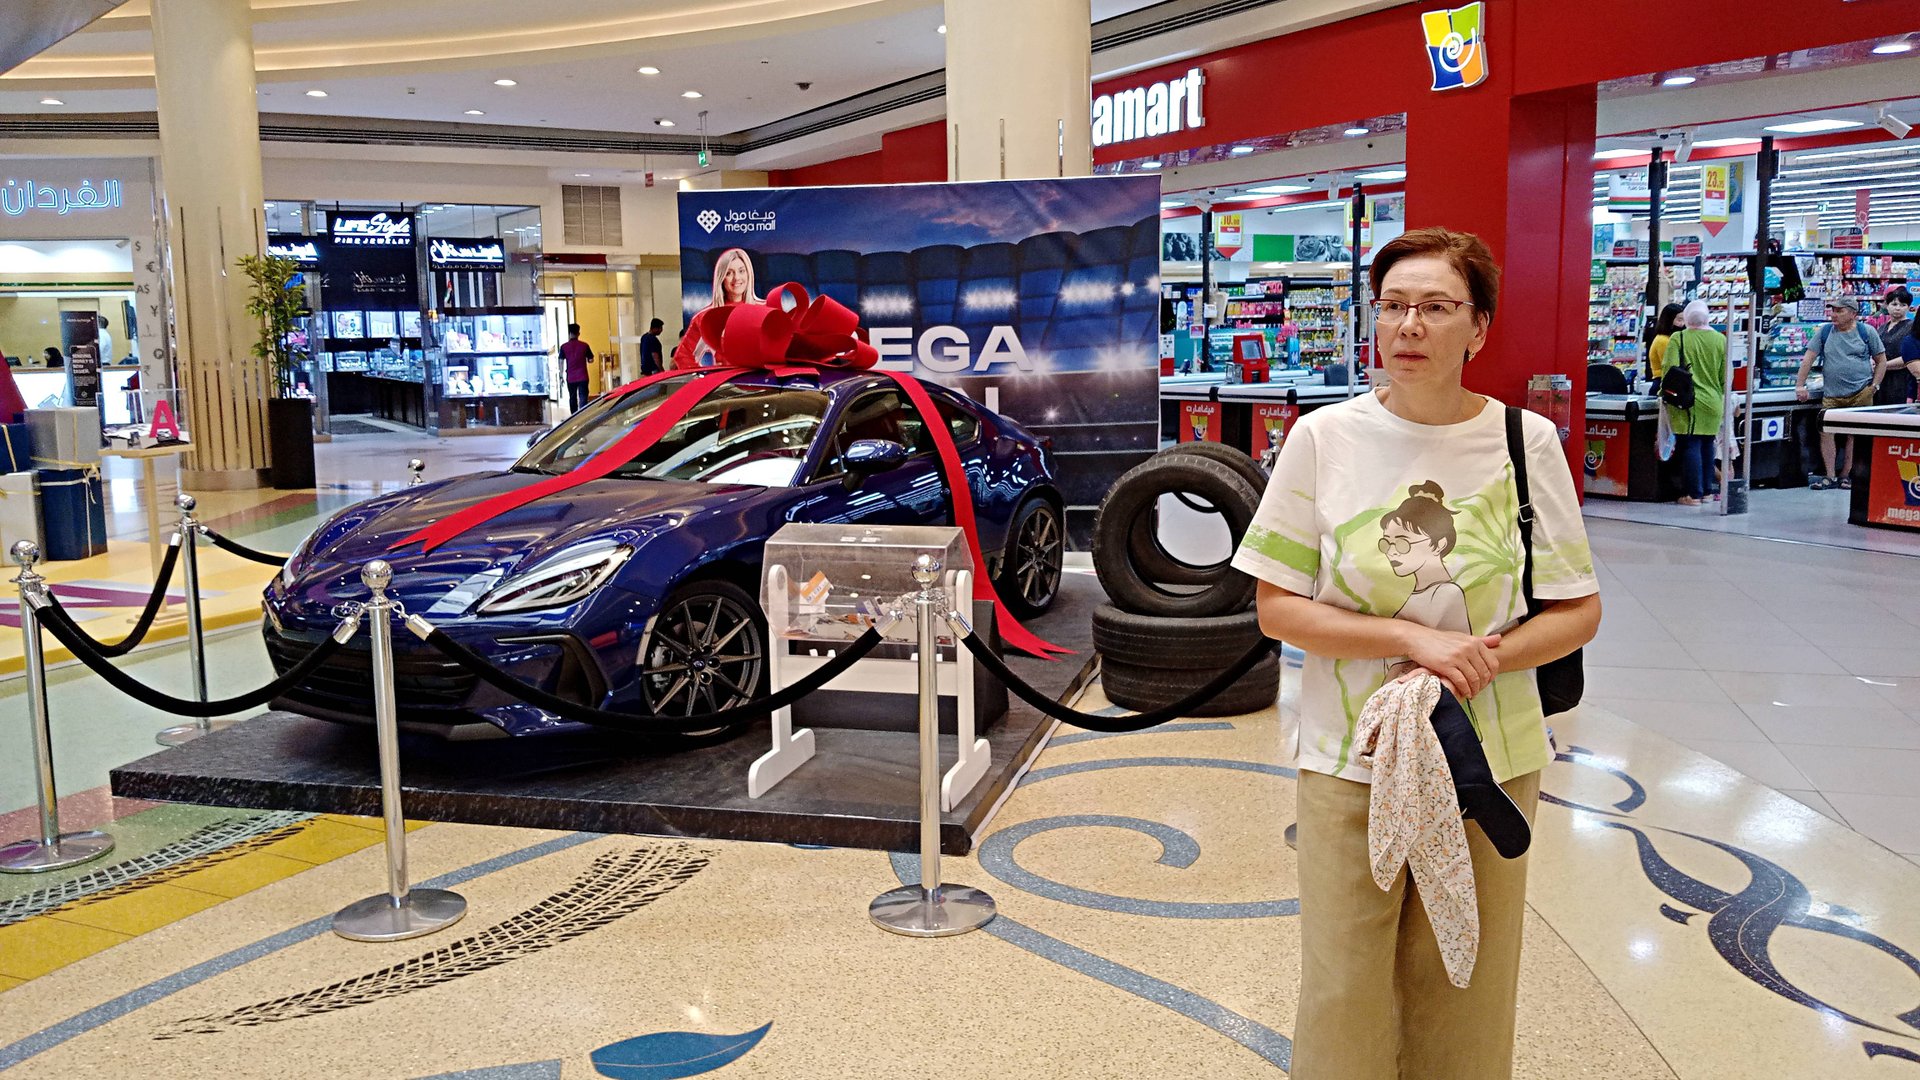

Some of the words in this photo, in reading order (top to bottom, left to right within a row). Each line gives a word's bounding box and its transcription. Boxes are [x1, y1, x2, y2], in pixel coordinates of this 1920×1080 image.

[1091, 67, 1202, 147] amart
[2, 180, 120, 215] الفردان
[724, 209, 747, 223] مول
[724, 223, 755, 234] mega
[756, 219, 776, 231] mall
[748, 209, 776, 222] ميغا
[868, 325, 1034, 373] EGA
[149, 399, 180, 438] A
[1887, 507, 1920, 522] mega
